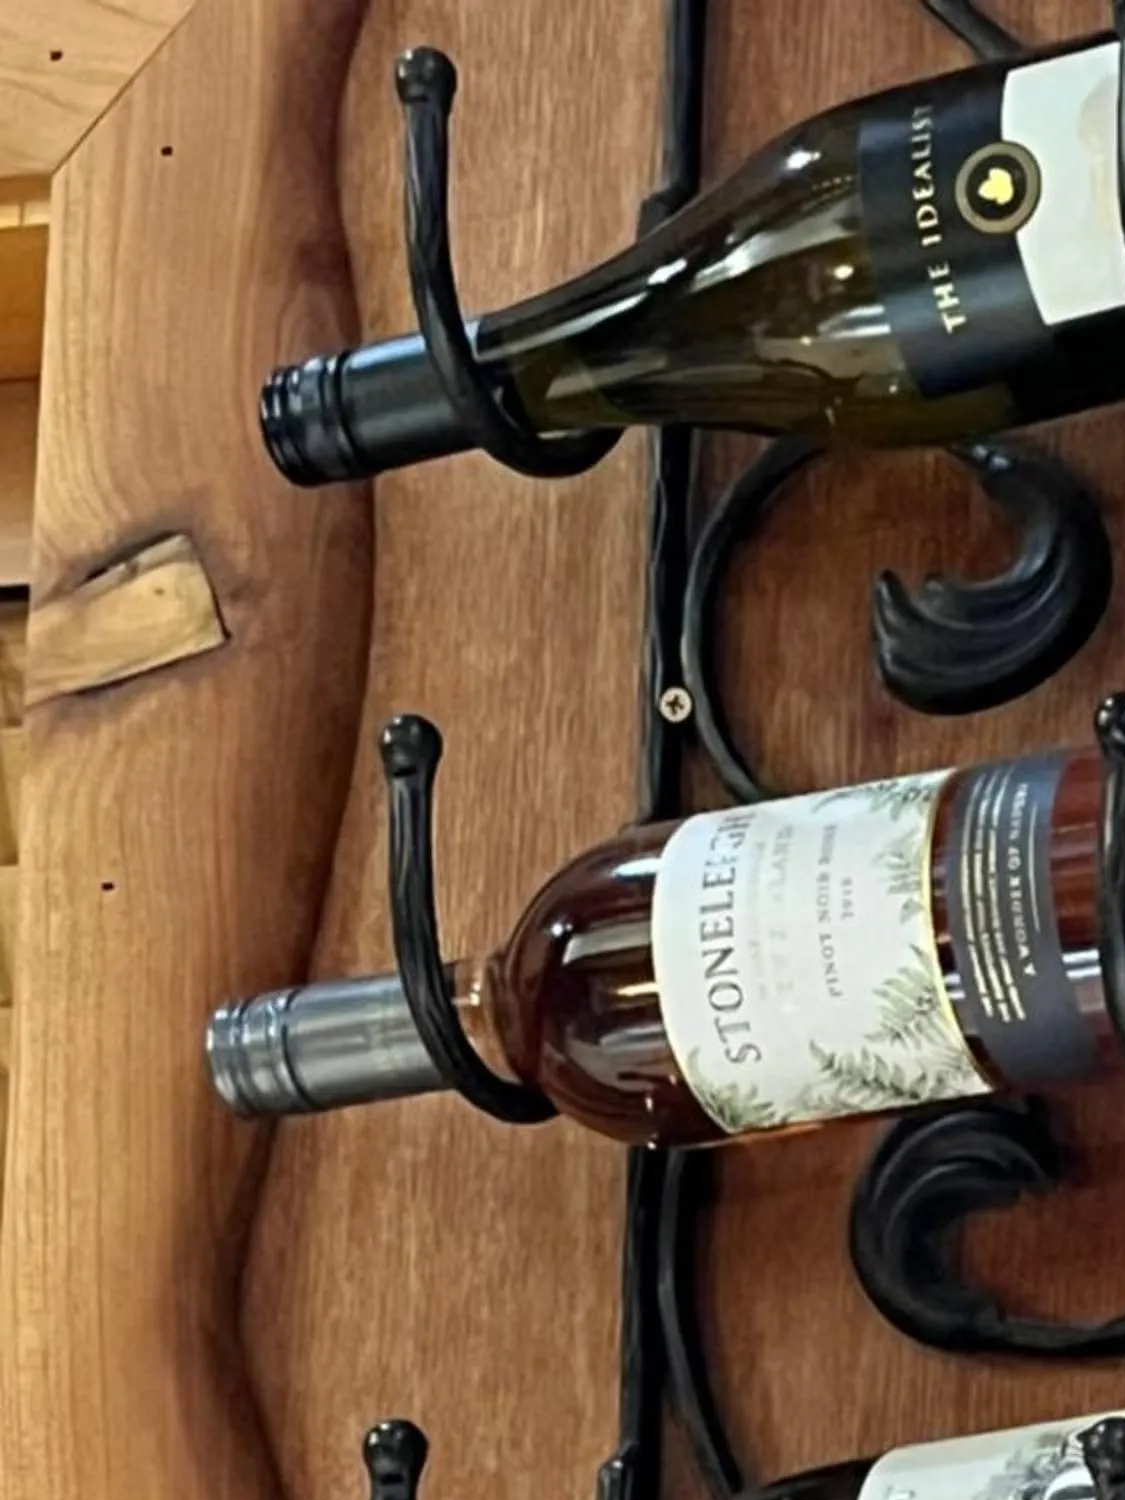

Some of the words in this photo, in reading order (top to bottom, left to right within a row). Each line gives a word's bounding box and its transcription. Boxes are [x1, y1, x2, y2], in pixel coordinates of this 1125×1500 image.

[911, 105, 943, 247] IDEALIST
[925, 264, 967, 334] THE
[816, 871, 831, 923] NOIR
[820, 932, 843, 997] PINOT
